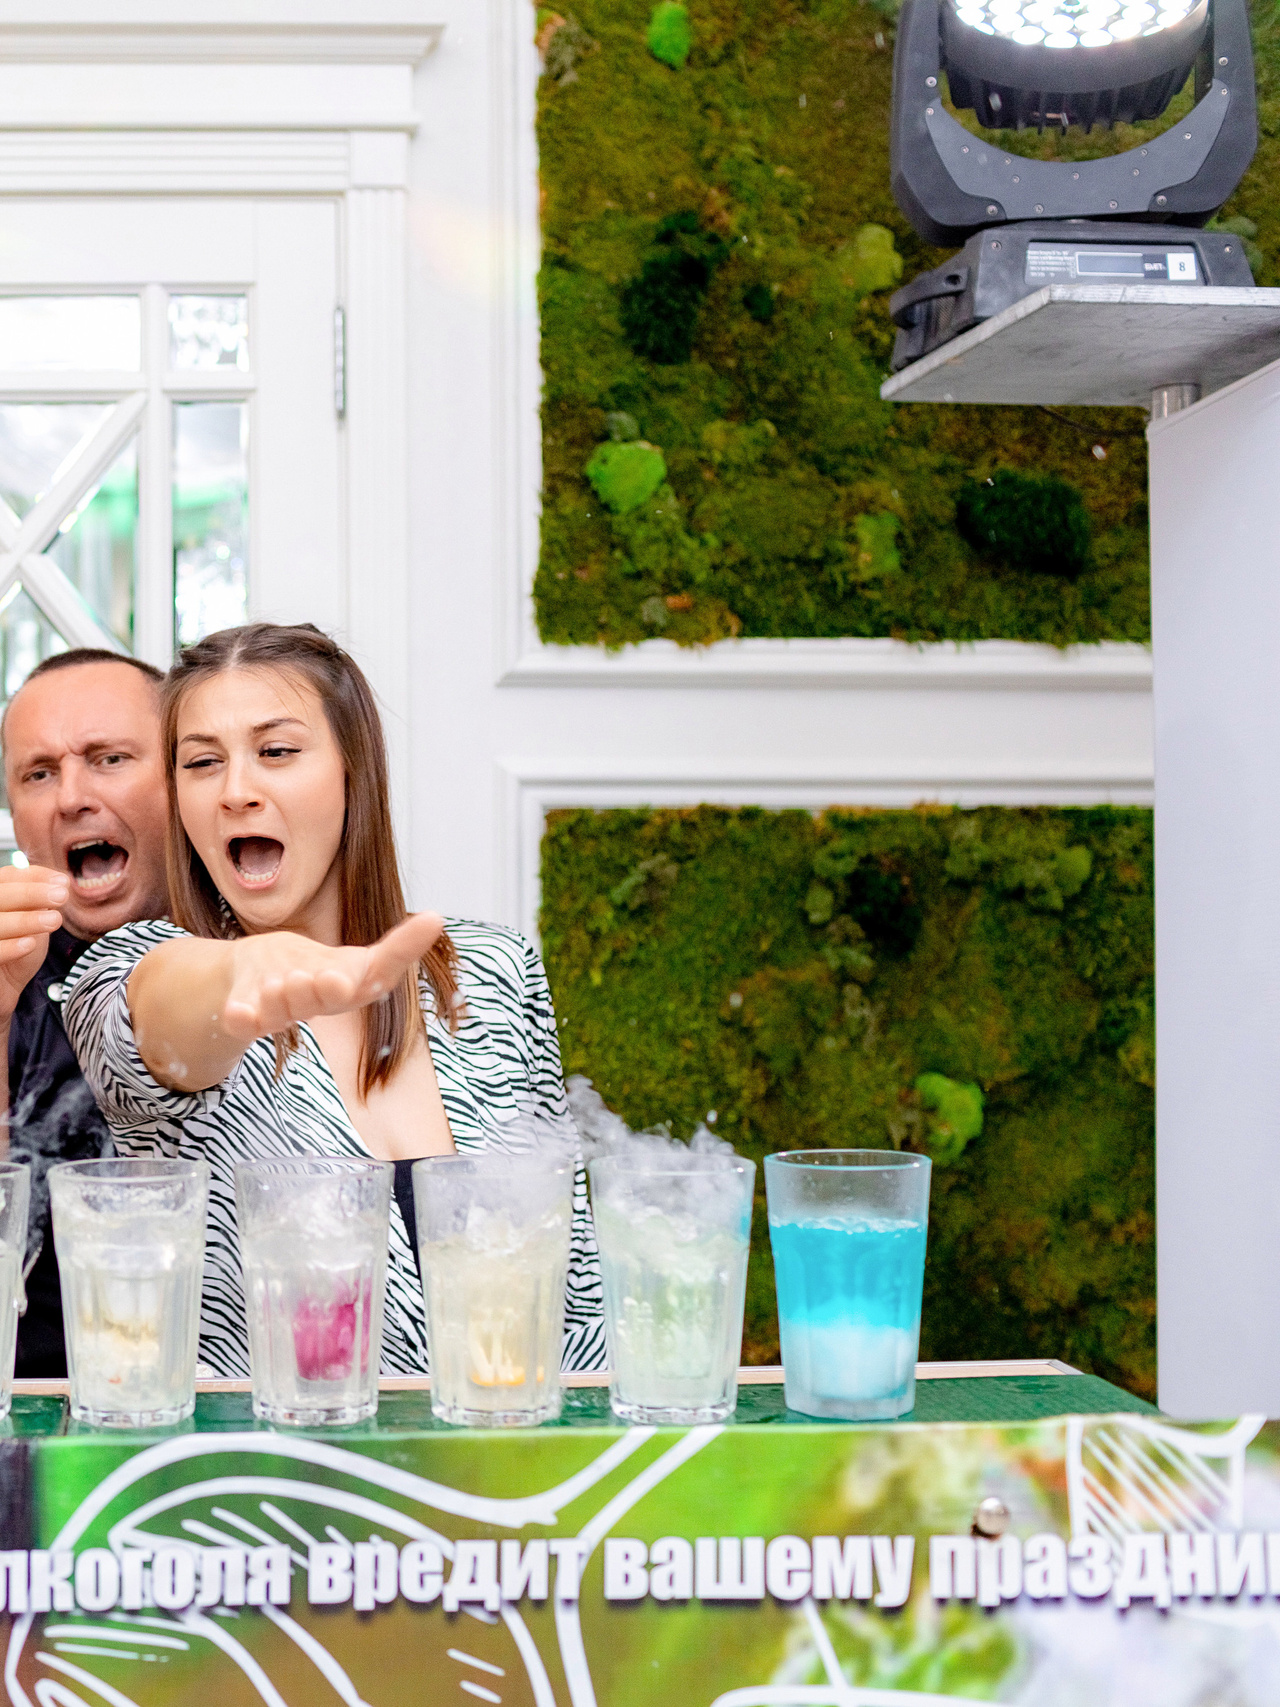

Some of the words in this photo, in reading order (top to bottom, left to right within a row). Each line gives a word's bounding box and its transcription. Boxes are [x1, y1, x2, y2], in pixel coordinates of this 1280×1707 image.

[1179, 261, 1186, 272] 8
[308, 1538, 588, 1612] вредит
[603, 1536, 914, 1607] вашему
